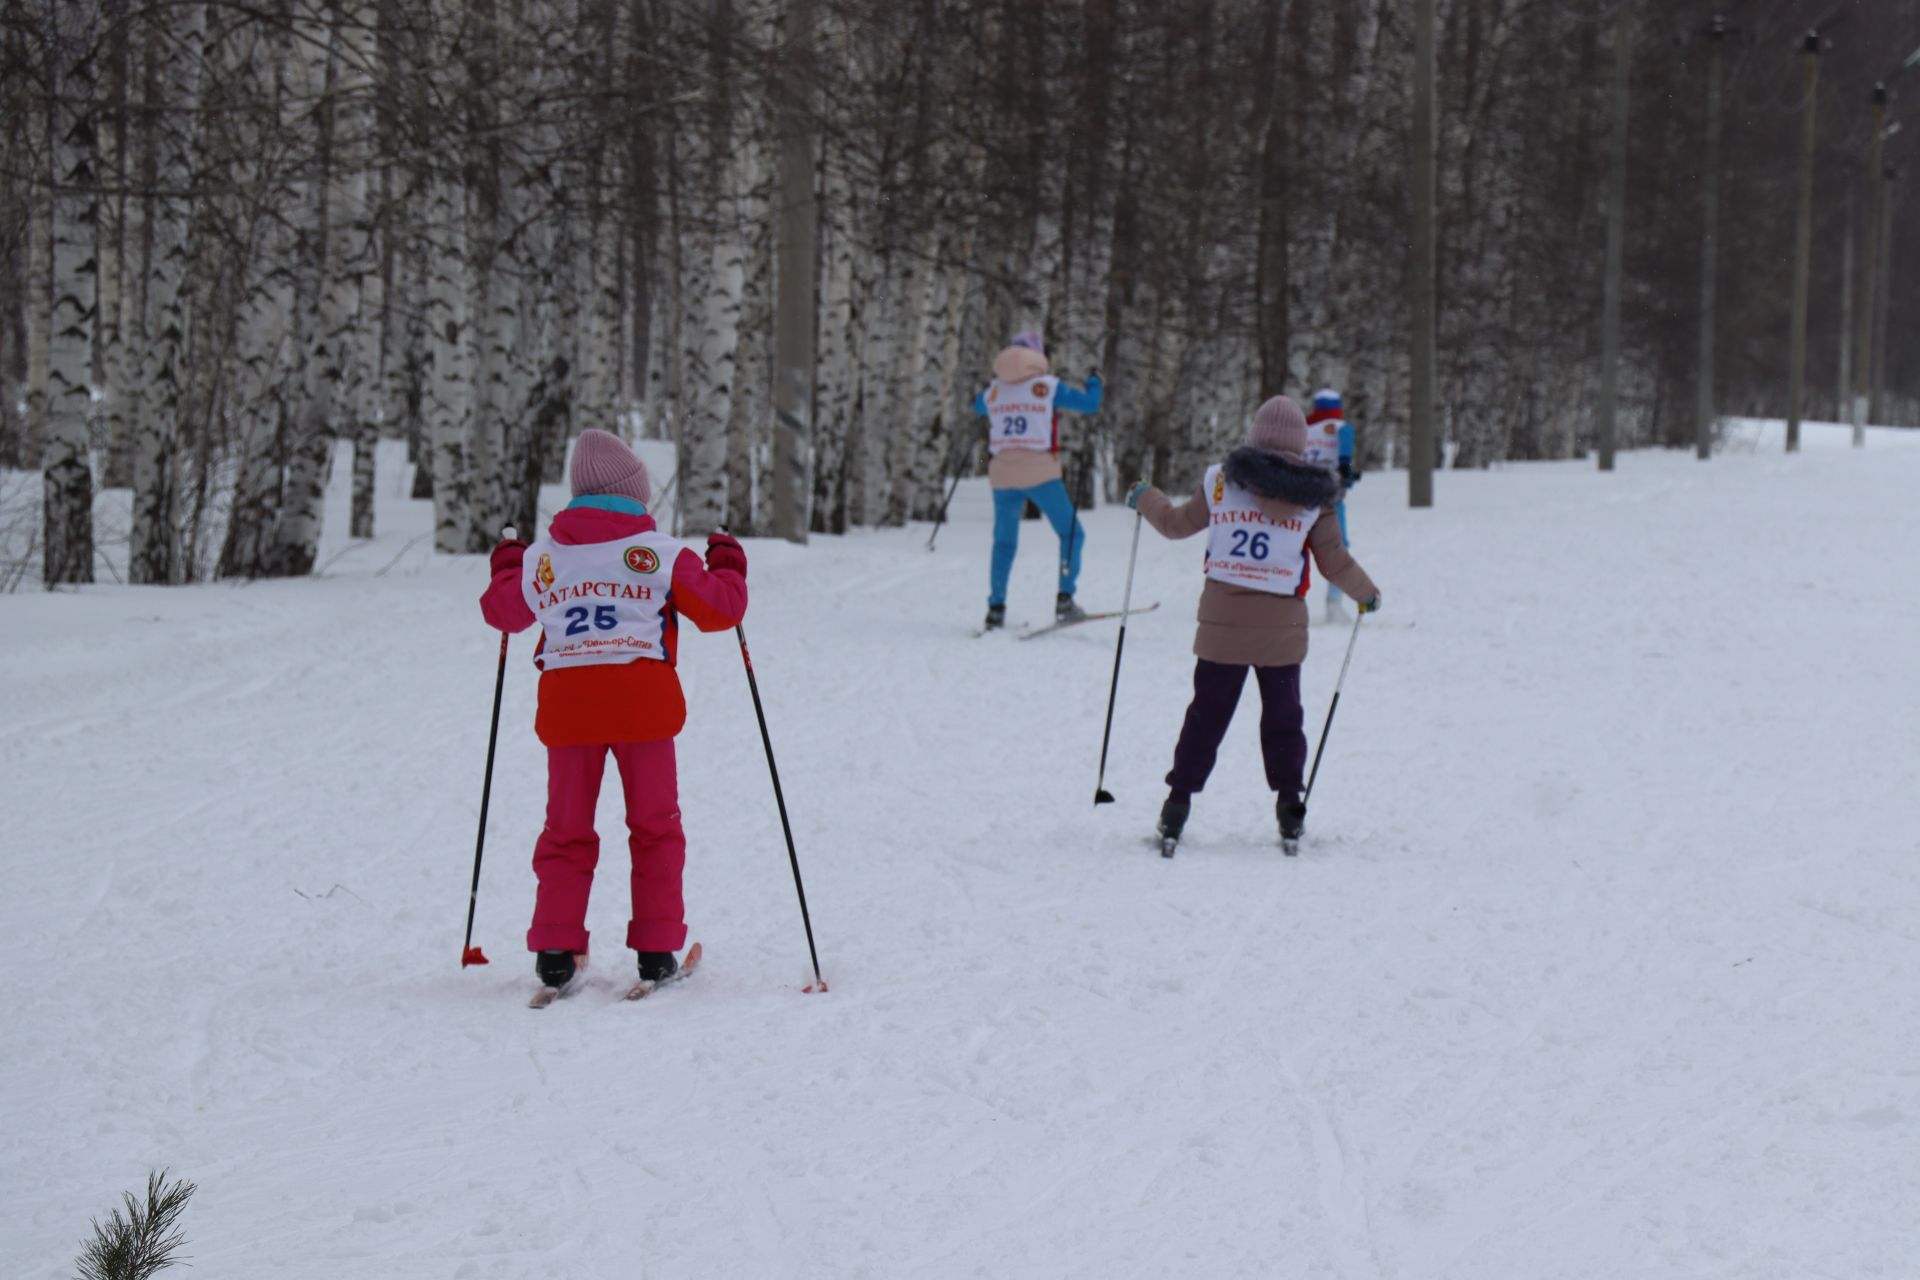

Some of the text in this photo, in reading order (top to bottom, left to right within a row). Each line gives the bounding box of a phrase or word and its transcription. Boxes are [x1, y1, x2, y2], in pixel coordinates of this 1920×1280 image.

[1003, 415, 1027, 436] 29
[1229, 528, 1270, 560] 26
[565, 605, 618, 636] 25
